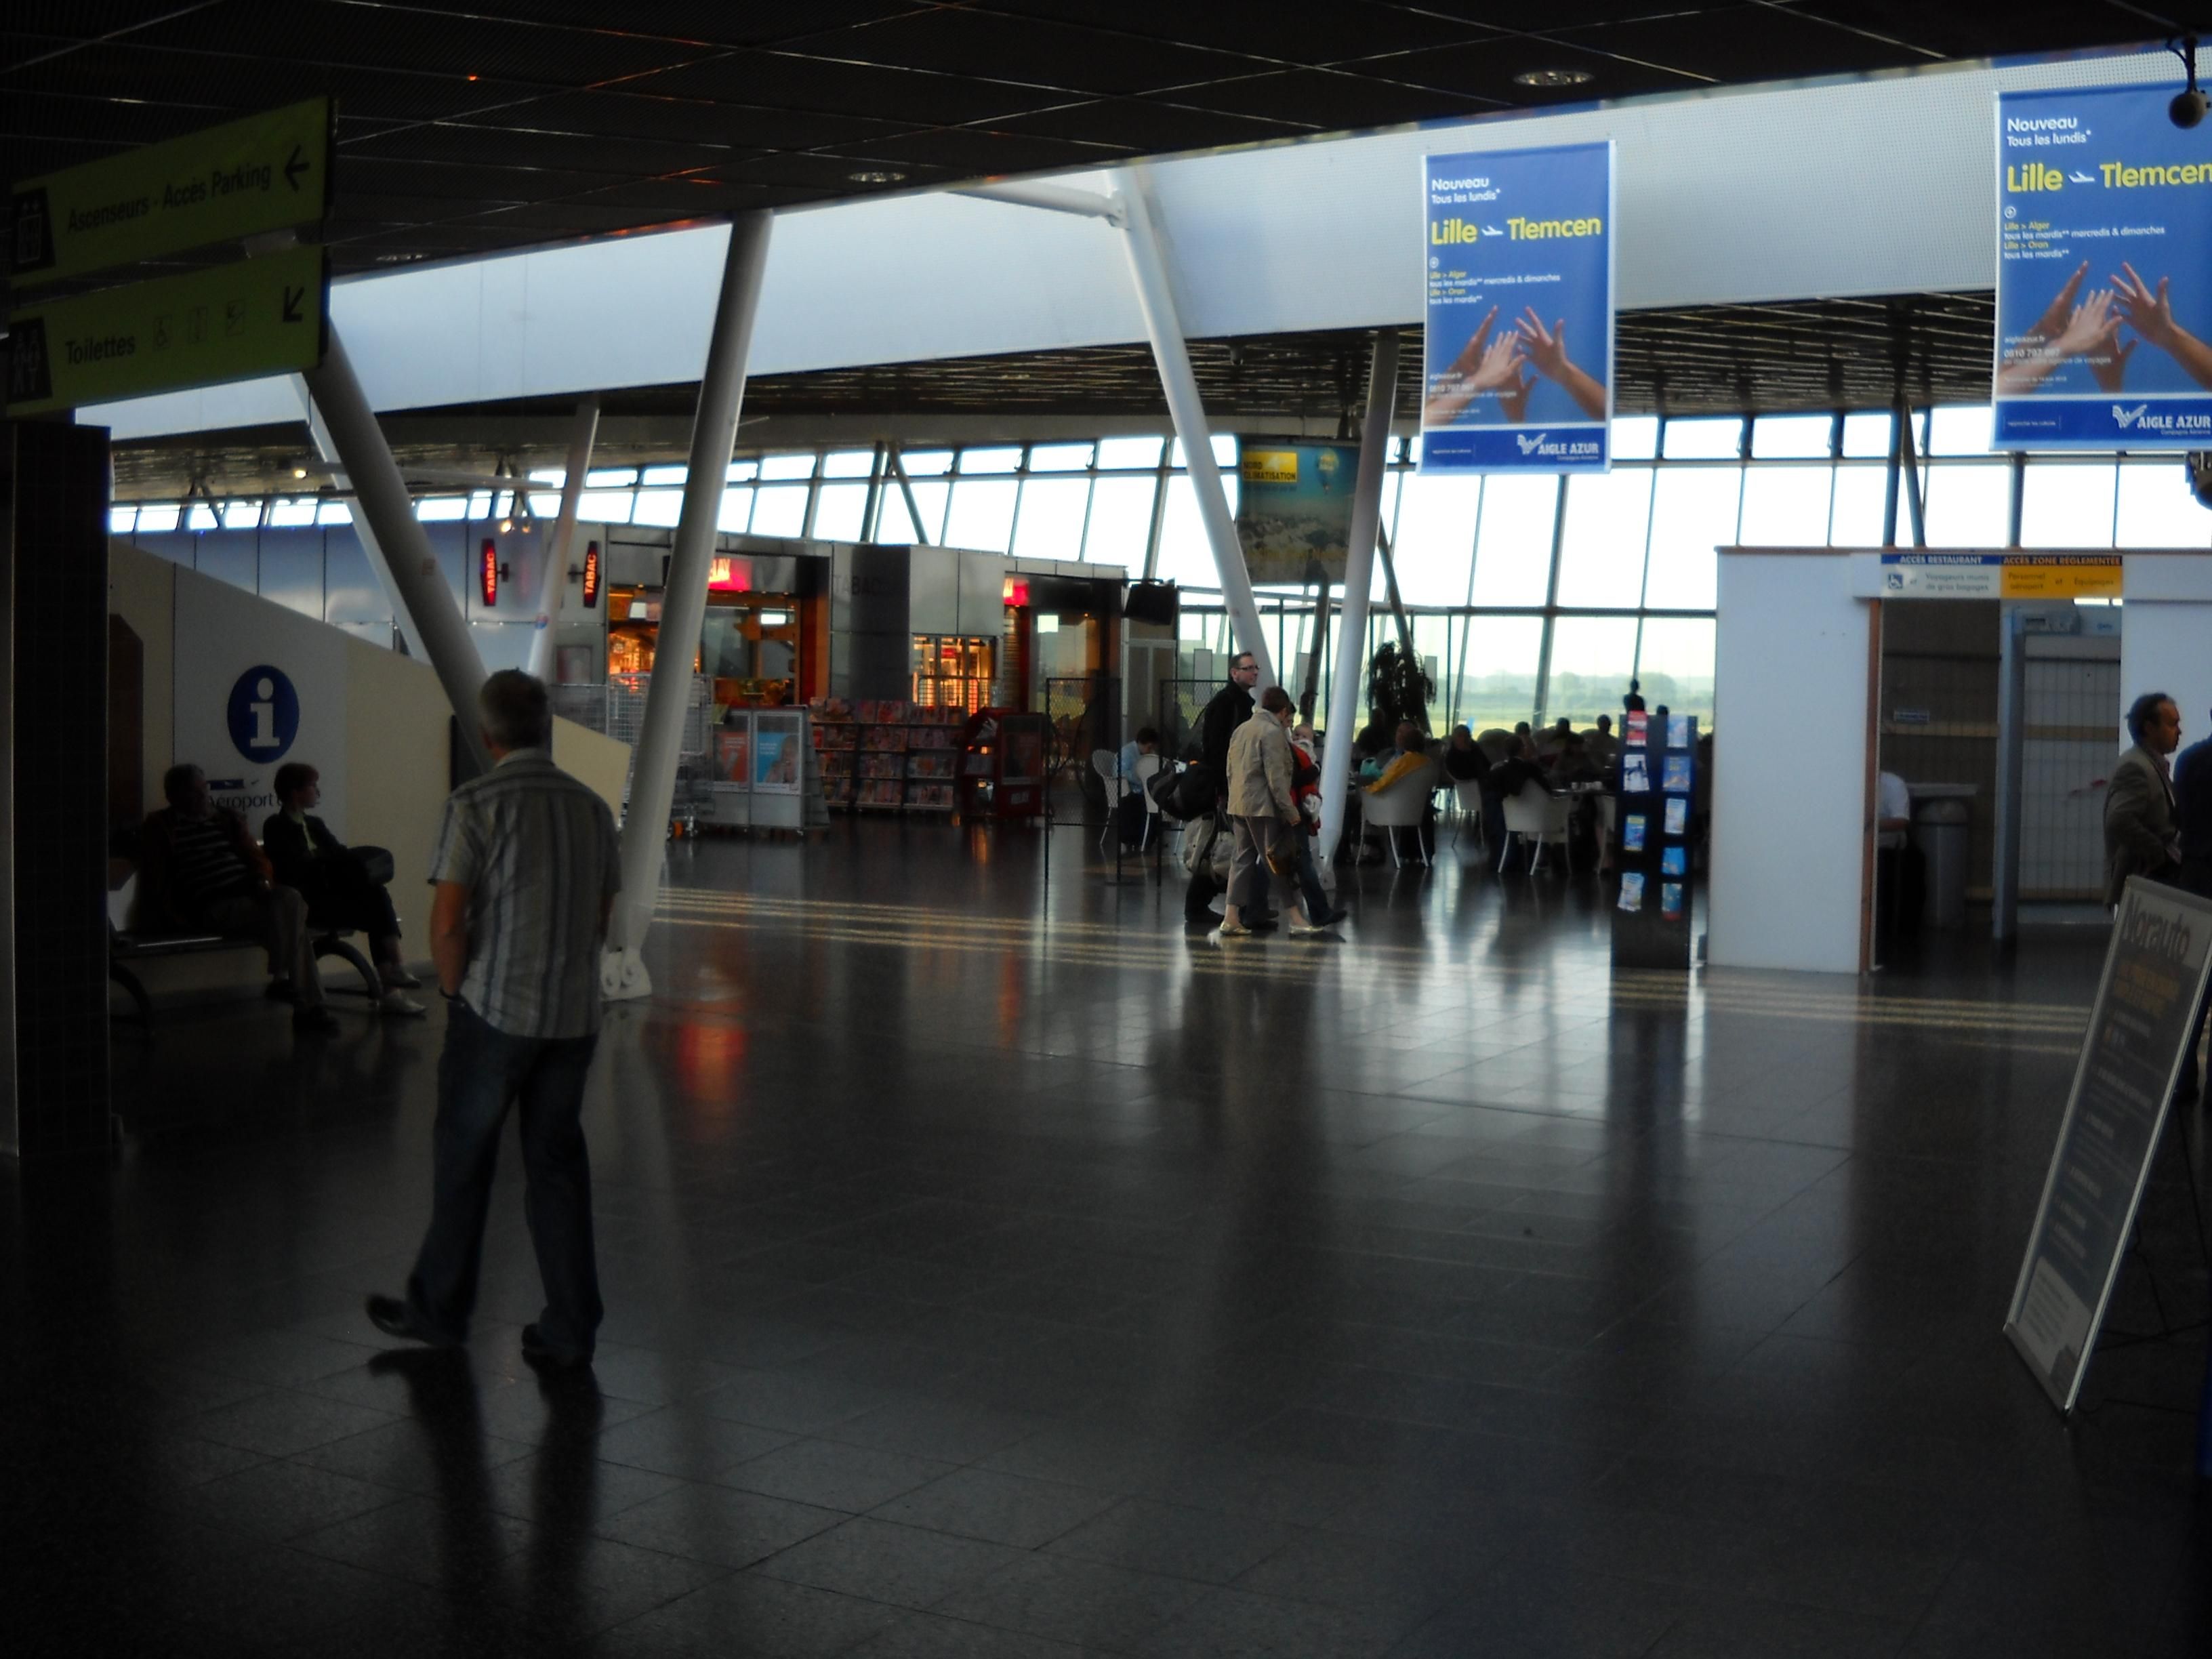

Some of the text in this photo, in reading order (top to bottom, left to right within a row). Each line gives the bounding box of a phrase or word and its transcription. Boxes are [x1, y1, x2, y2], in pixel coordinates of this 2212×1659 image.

[2007, 117, 2077, 132] Nouveau
[2007, 136, 2032, 146] Tous
[2034, 134, 2050, 145] les
[2007, 161, 2212, 192] Lille Tlemcen
[1431, 178, 1489, 190] Nouveau
[68, 194, 149, 232] Ascenseurs
[163, 178, 206, 208] Accès
[211, 163, 272, 198] Parking
[1431, 194, 1452, 203] Tous
[1454, 192, 1467, 203] les
[1431, 217, 1601, 245] Lille Tlemcen
[2071, 228, 2110, 238] mercredis
[2121, 226, 2165, 235] dimanches
[66, 336, 136, 365] Toilettes
[2137, 415, 2211, 428] AIGLE AZUR
[1537, 443, 1599, 455] AIGLE AZUR
[1927, 555, 1983, 565] RESTAURANT
[2032, 556, 2058, 565] ZONE
[487, 553, 495, 594] TABAC
[584, 554, 597, 594] TABAC
[2124, 893, 2191, 960] Norauto
